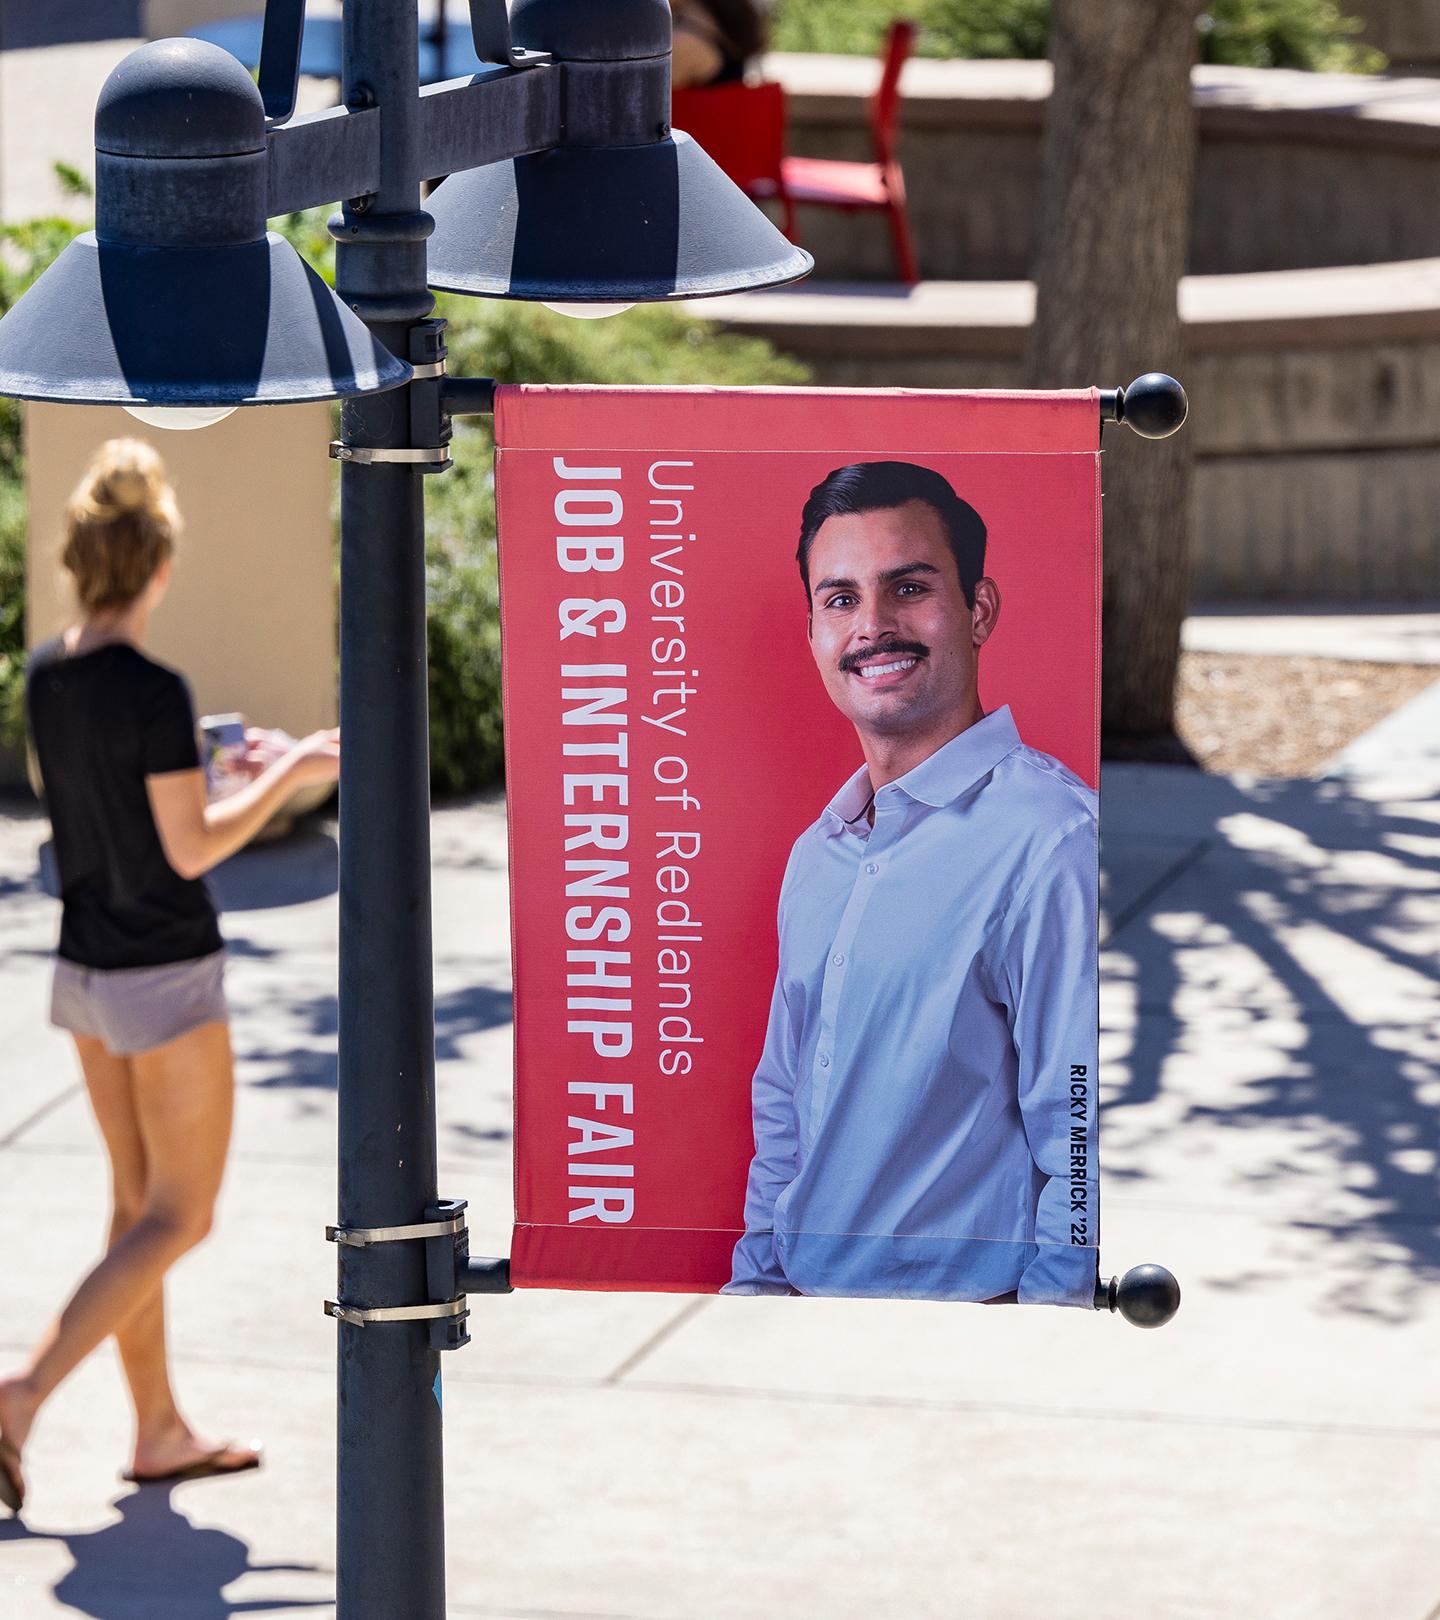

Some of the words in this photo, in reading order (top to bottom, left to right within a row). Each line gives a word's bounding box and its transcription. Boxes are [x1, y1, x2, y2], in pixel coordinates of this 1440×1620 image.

[552, 456, 625, 573] JOB
[558, 597, 627, 641] &
[640, 459, 699, 737] University
[654, 756, 701, 811] of
[560, 663, 633, 1058] INTERNSHIP
[655, 831, 704, 1076] Redlands
[1070, 1064, 1087, 1122] RICKY
[567, 1081, 635, 1224] FAIR
[1070, 1126, 1088, 1213] MERRICK
